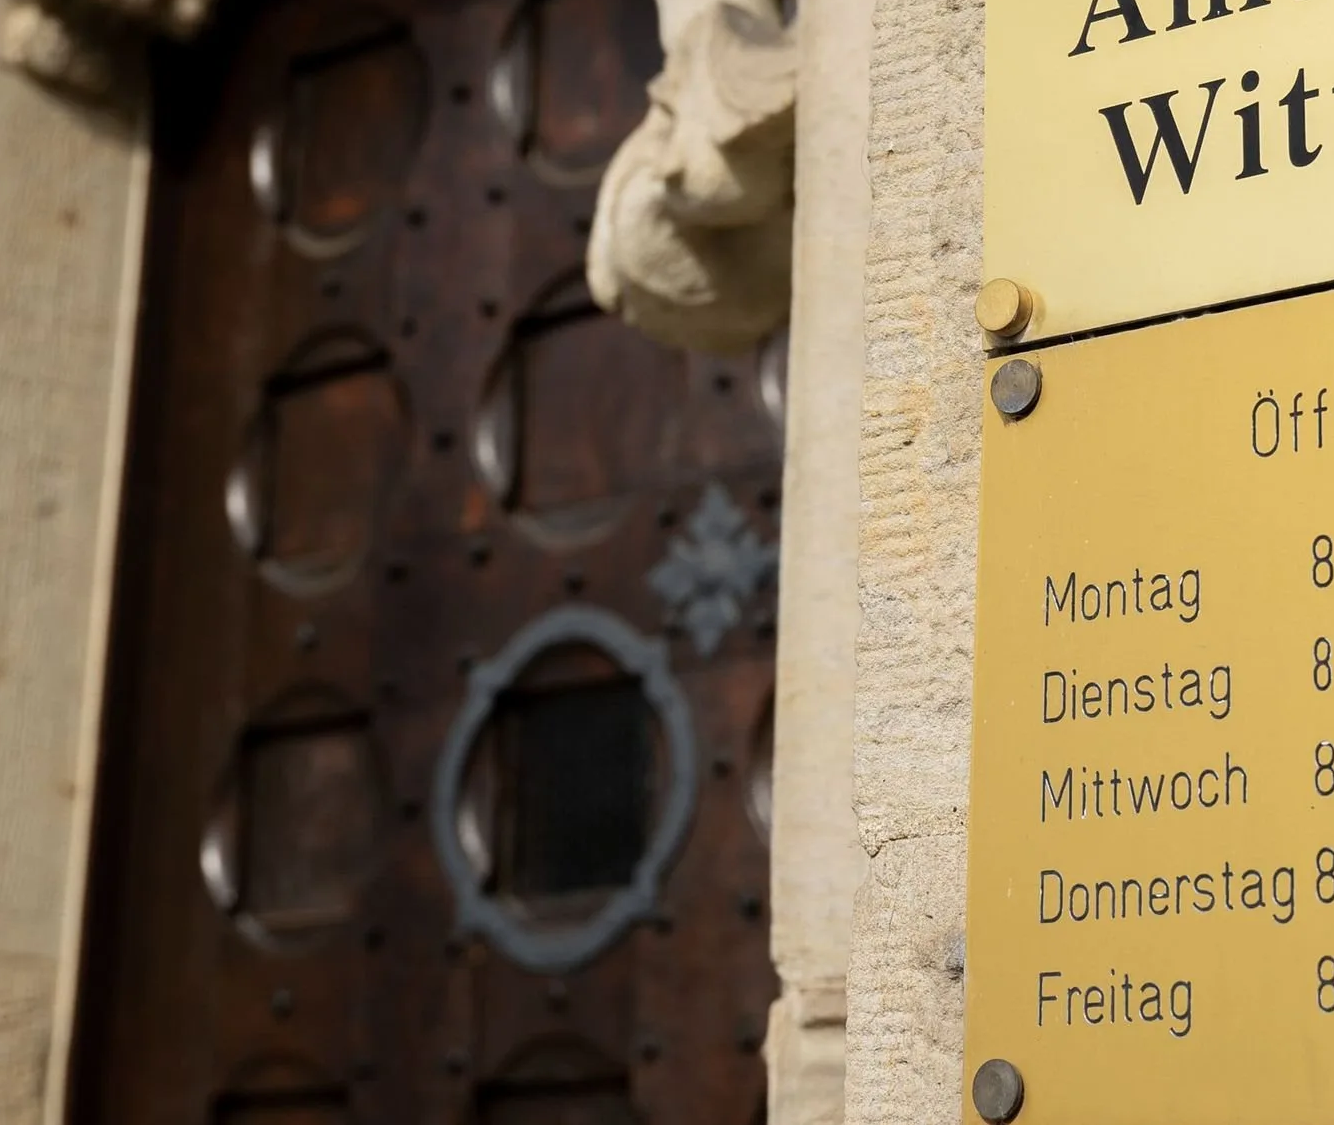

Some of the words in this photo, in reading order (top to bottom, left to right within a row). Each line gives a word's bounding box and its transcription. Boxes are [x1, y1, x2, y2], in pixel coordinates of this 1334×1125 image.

[1044, 567, 1201, 627] Montag
[1041, 662, 1232, 725] Dienstag
[1040, 751, 1249, 823] Mittwoch
[1038, 860, 1296, 925] Donnerstag
[1037, 971, 1193, 1038] Freitag
